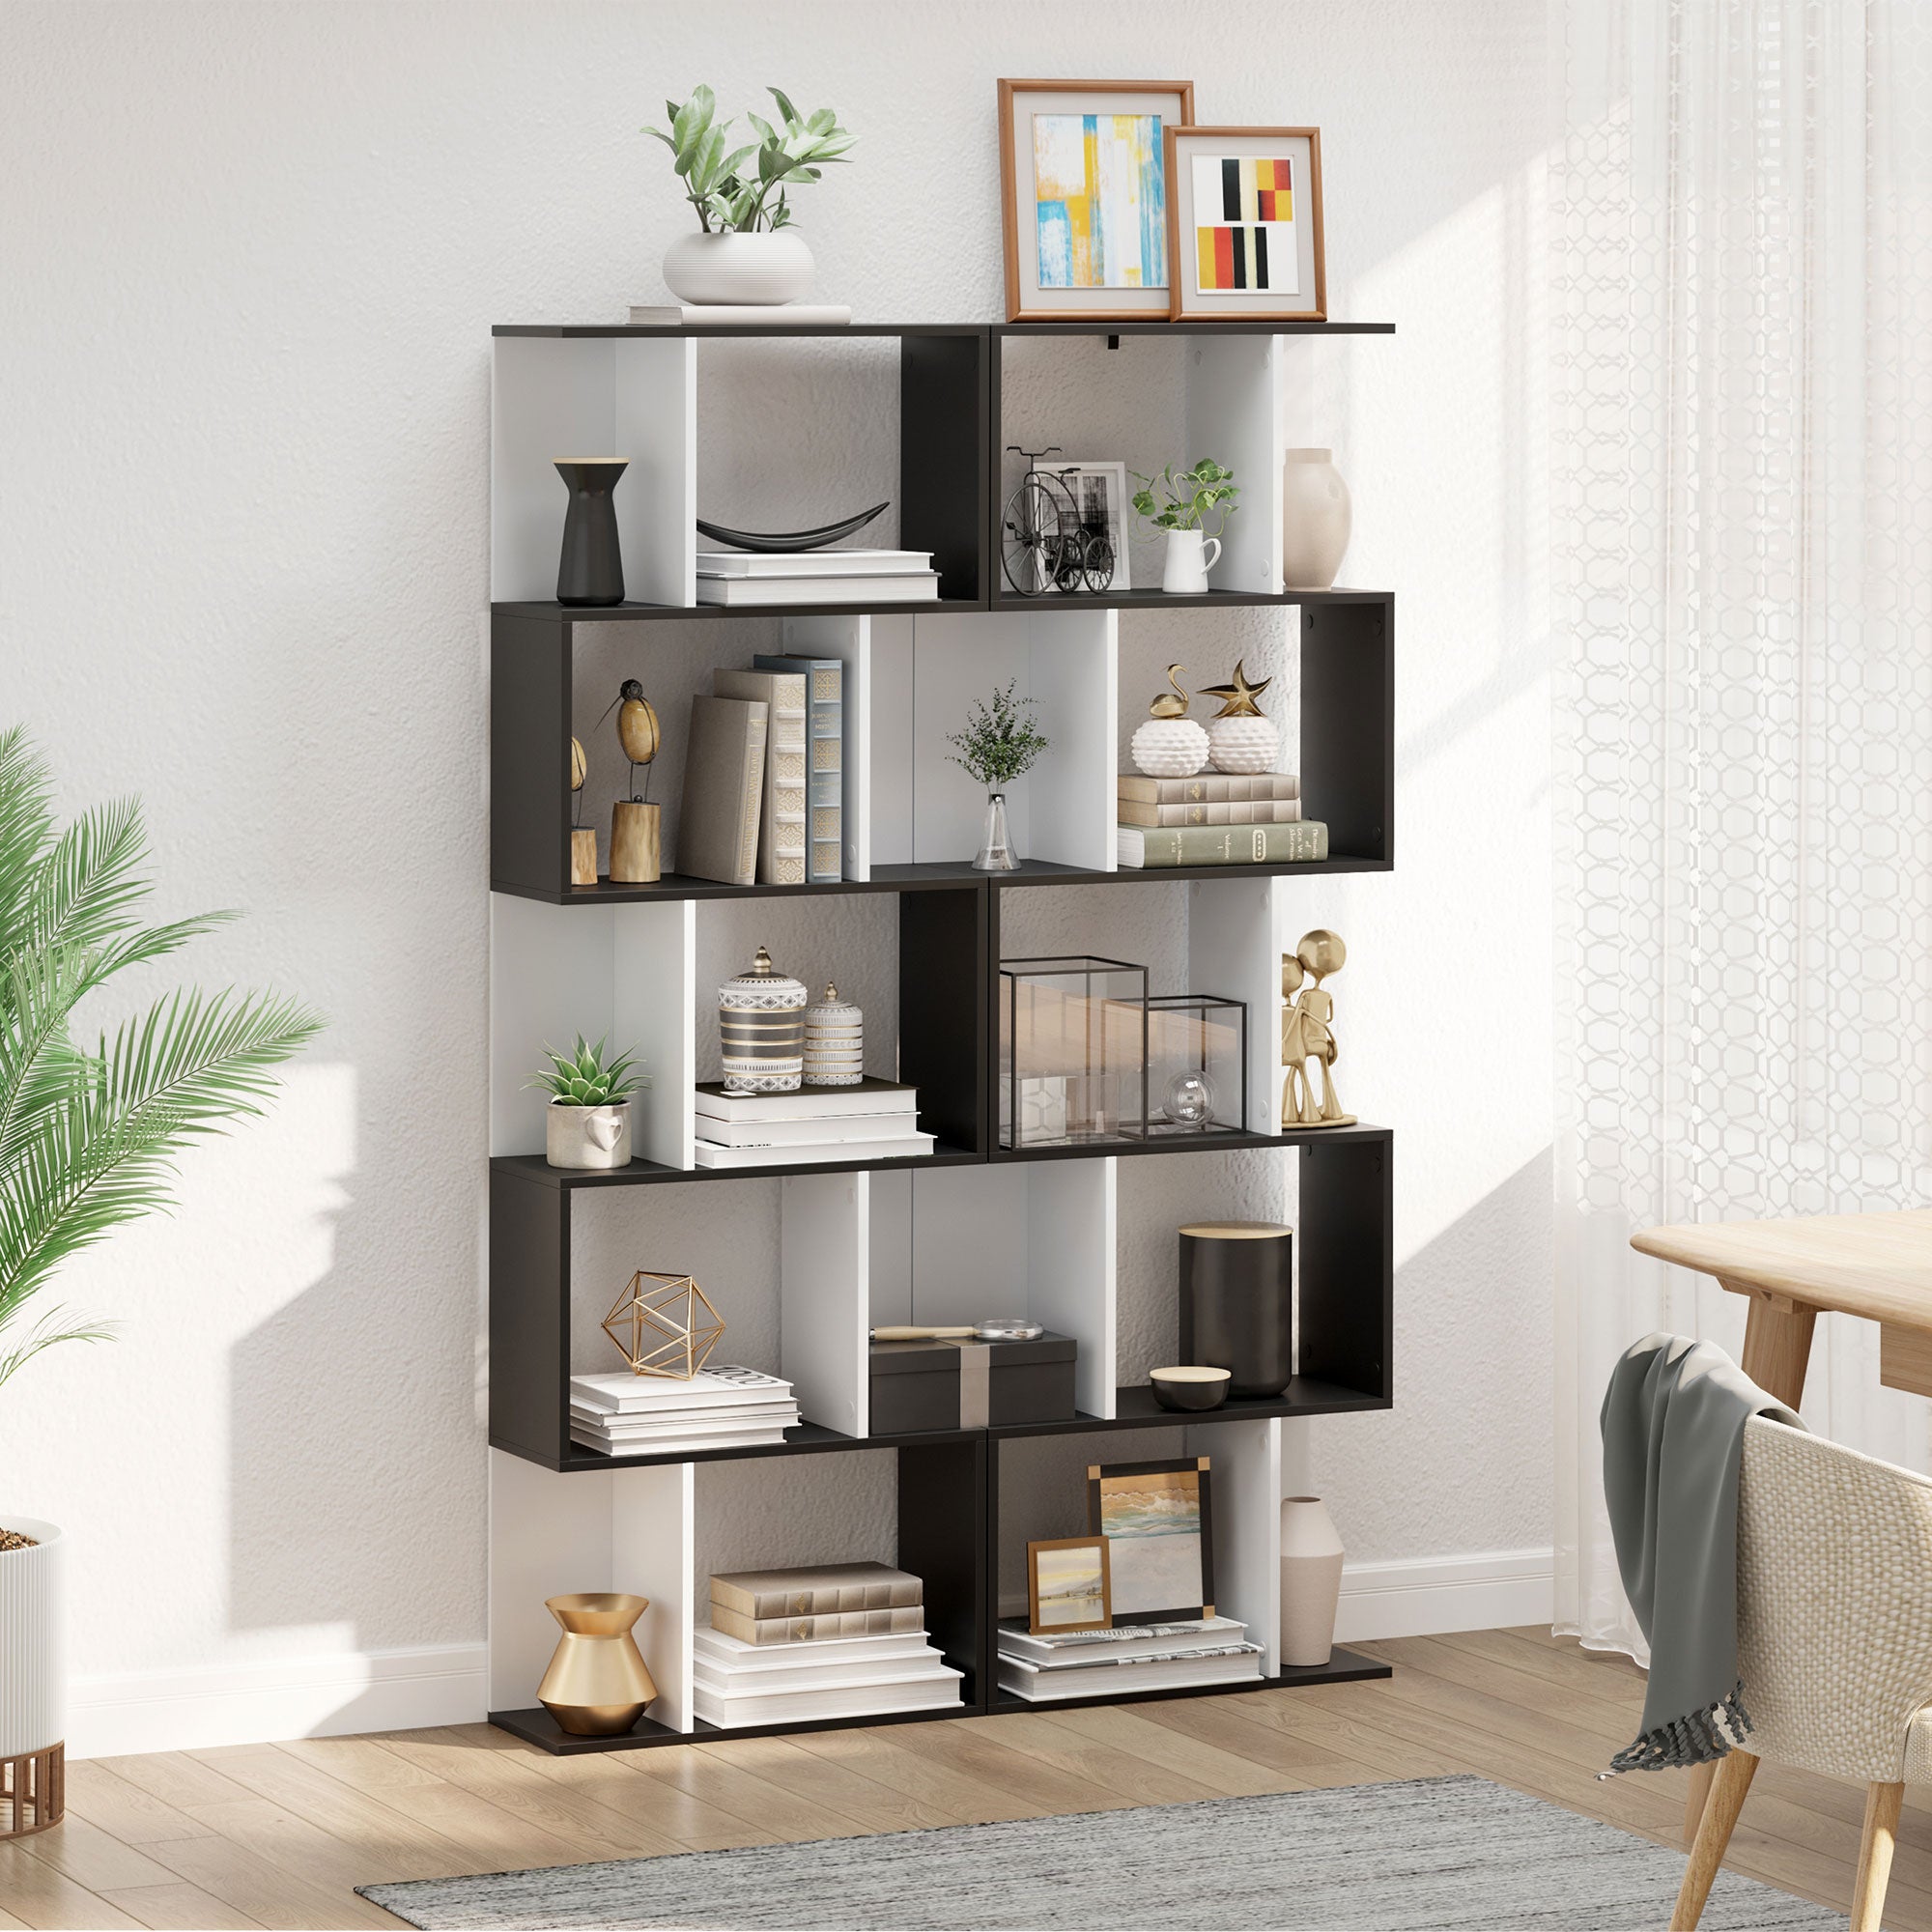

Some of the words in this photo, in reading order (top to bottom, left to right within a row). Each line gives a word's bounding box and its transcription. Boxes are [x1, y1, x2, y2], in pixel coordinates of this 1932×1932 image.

[750, 751, 760, 774] LOVE
[749, 777, 758, 791] WE
[746, 793, 757, 826] THINGS
[744, 829, 753, 845] THE
